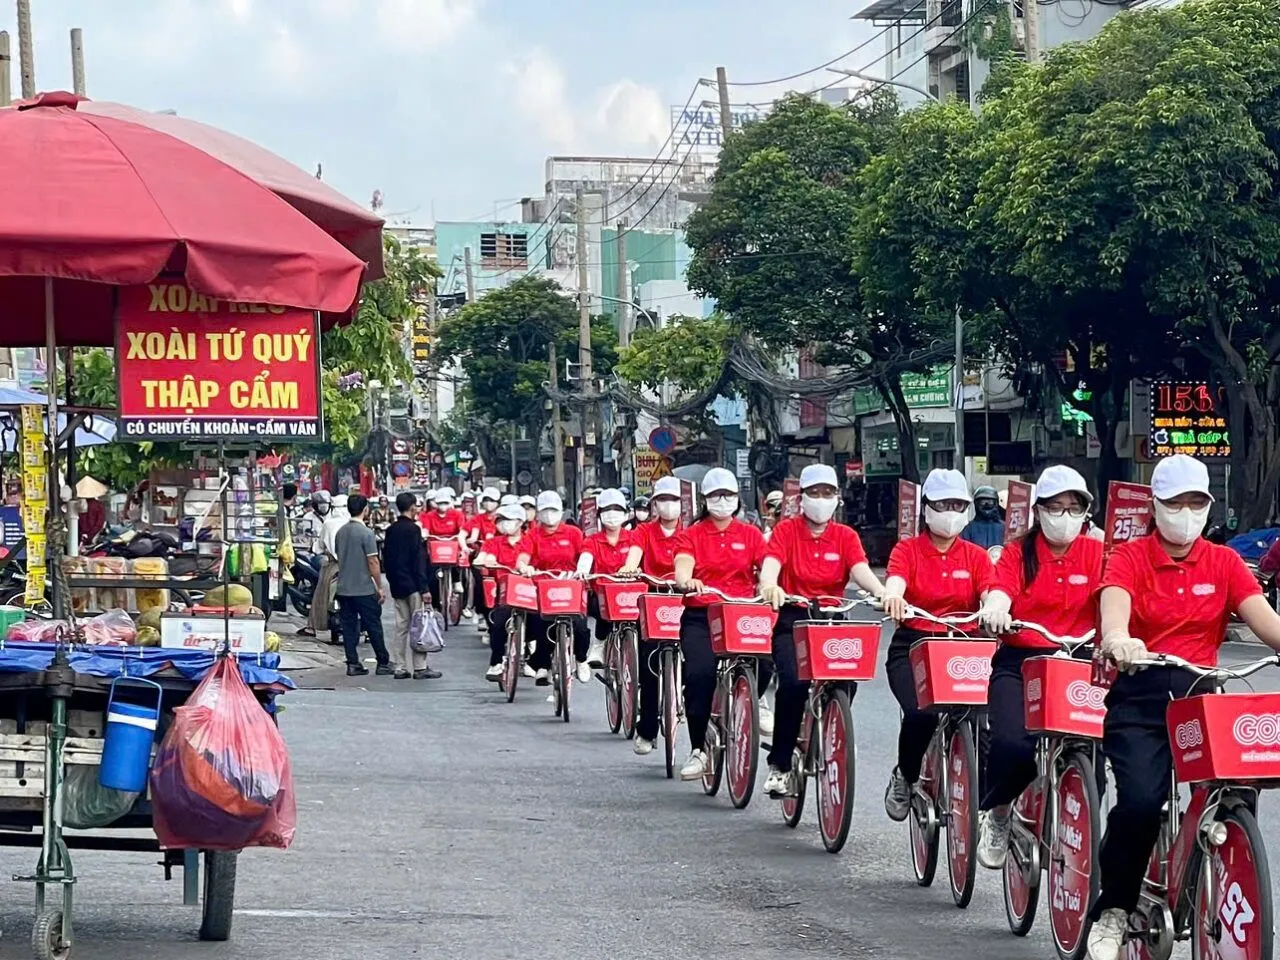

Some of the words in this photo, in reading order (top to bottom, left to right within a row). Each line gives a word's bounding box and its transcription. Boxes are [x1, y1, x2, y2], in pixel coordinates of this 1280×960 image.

[126, 327, 196, 360] XOÀI
[206, 328, 246, 361] TỨ
[253, 328, 311, 365] QUÝ
[141, 375, 220, 414] THẬP
[230, 370, 299, 409] CẨM
[126, 420, 145, 435] CÓ
[149, 418, 200, 435] CHUYỂN
[290, 420, 316, 436] VÂN
[1113, 519, 1132, 540] 25
[822, 638, 863, 659] GO!
[946, 656, 992, 680] GO!
[1066, 679, 1109, 711] GO
[1174, 718, 1203, 750] GO!
[1221, 881, 1255, 943] 25
